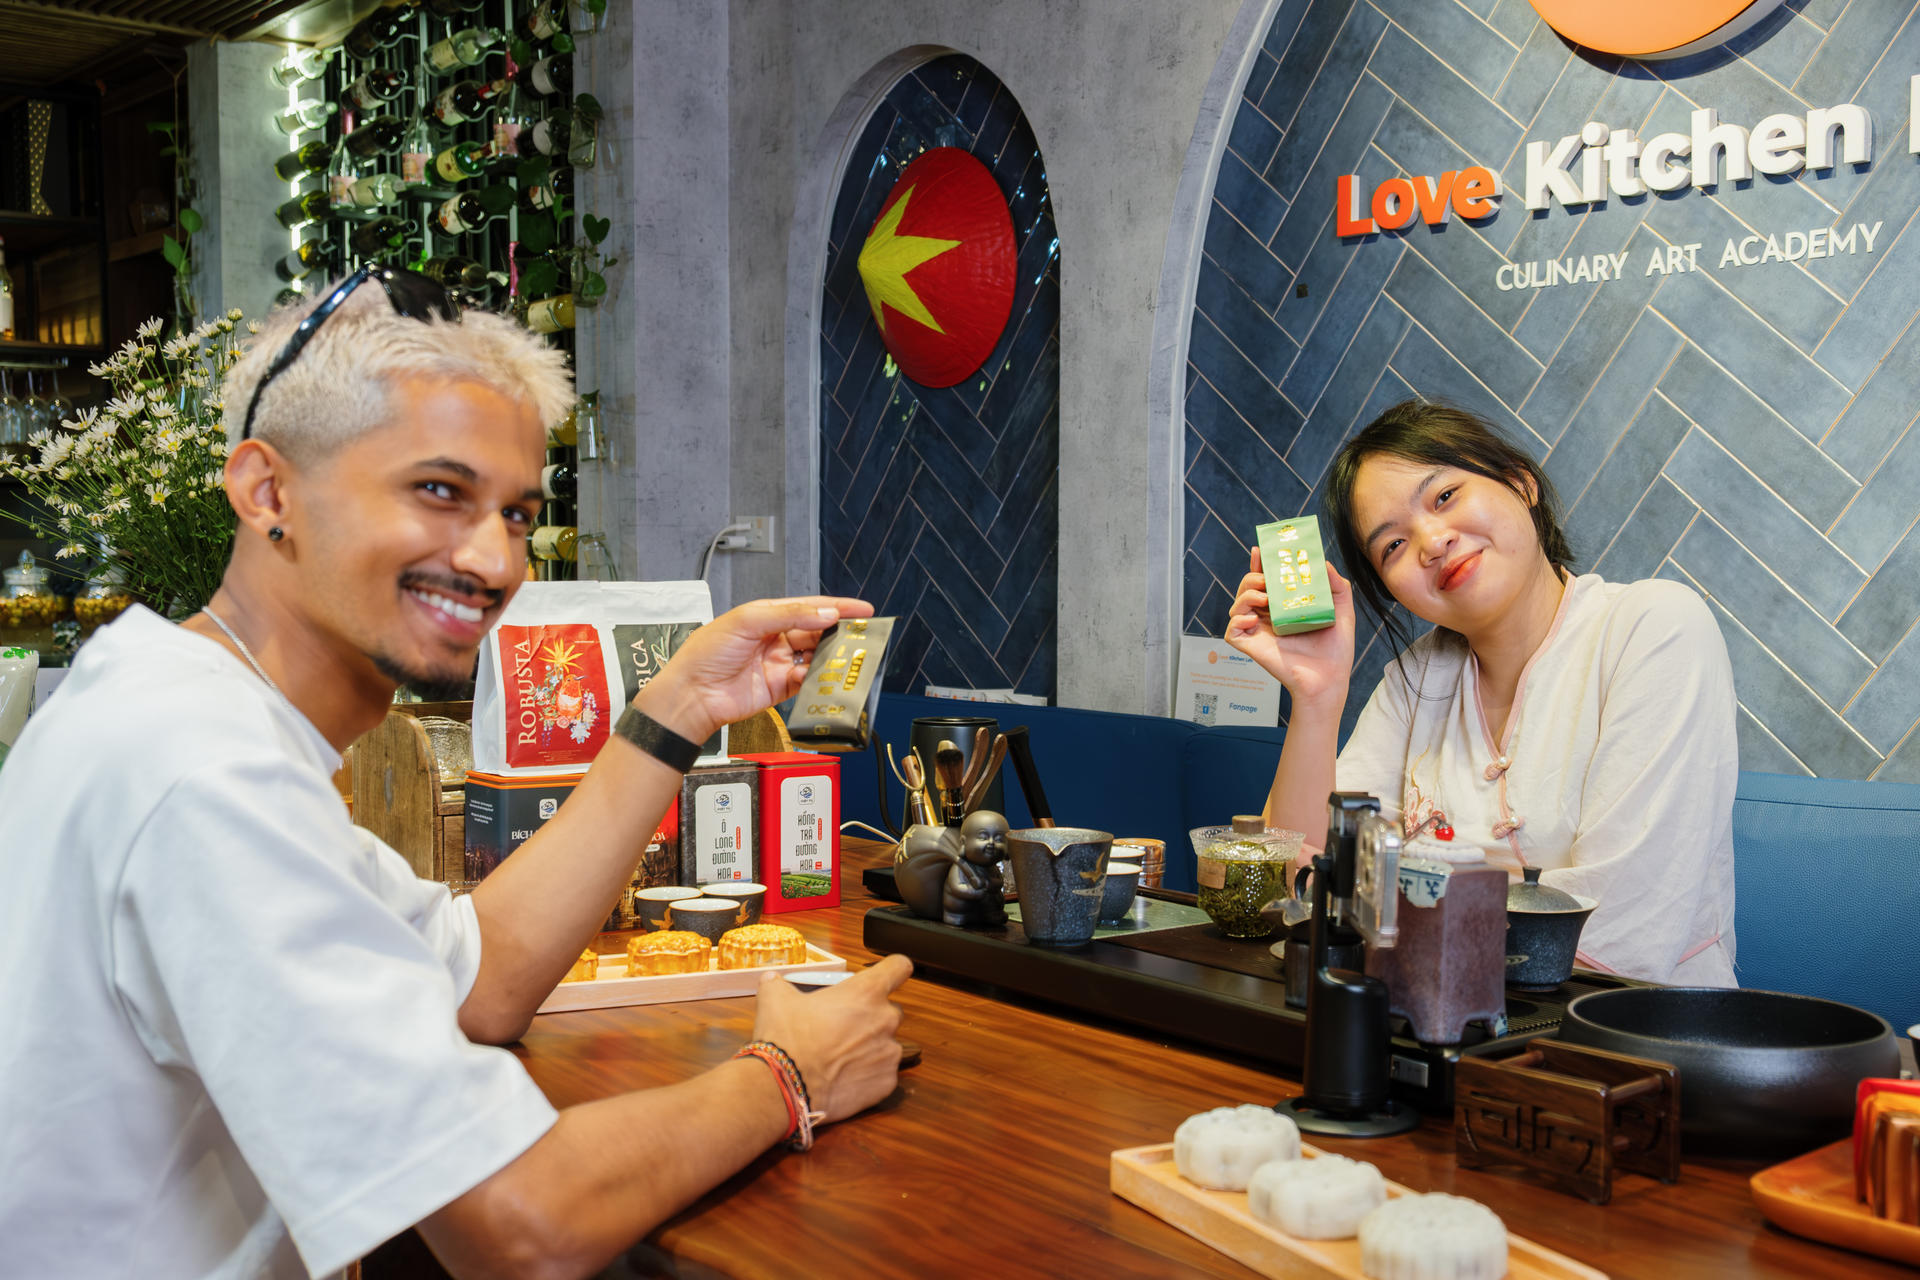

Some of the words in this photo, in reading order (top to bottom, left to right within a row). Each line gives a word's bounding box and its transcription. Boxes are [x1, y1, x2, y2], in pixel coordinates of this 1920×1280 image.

[1336, 166, 1503, 237] Love
[1525, 103, 1873, 211] Kitchen
[1495, 251, 1629, 291] CULINARY
[1645, 243, 1702, 277] ART
[1718, 221, 1884, 270] ACADEMY
[630, 638, 653, 690] BICA
[514, 639, 538, 745] ROBUSTA
[1229, 702, 1258, 714] Fanpage
[715, 837, 734, 850] LONG
[717, 867, 732, 881] HOA
[800, 859, 813, 872] HOA
